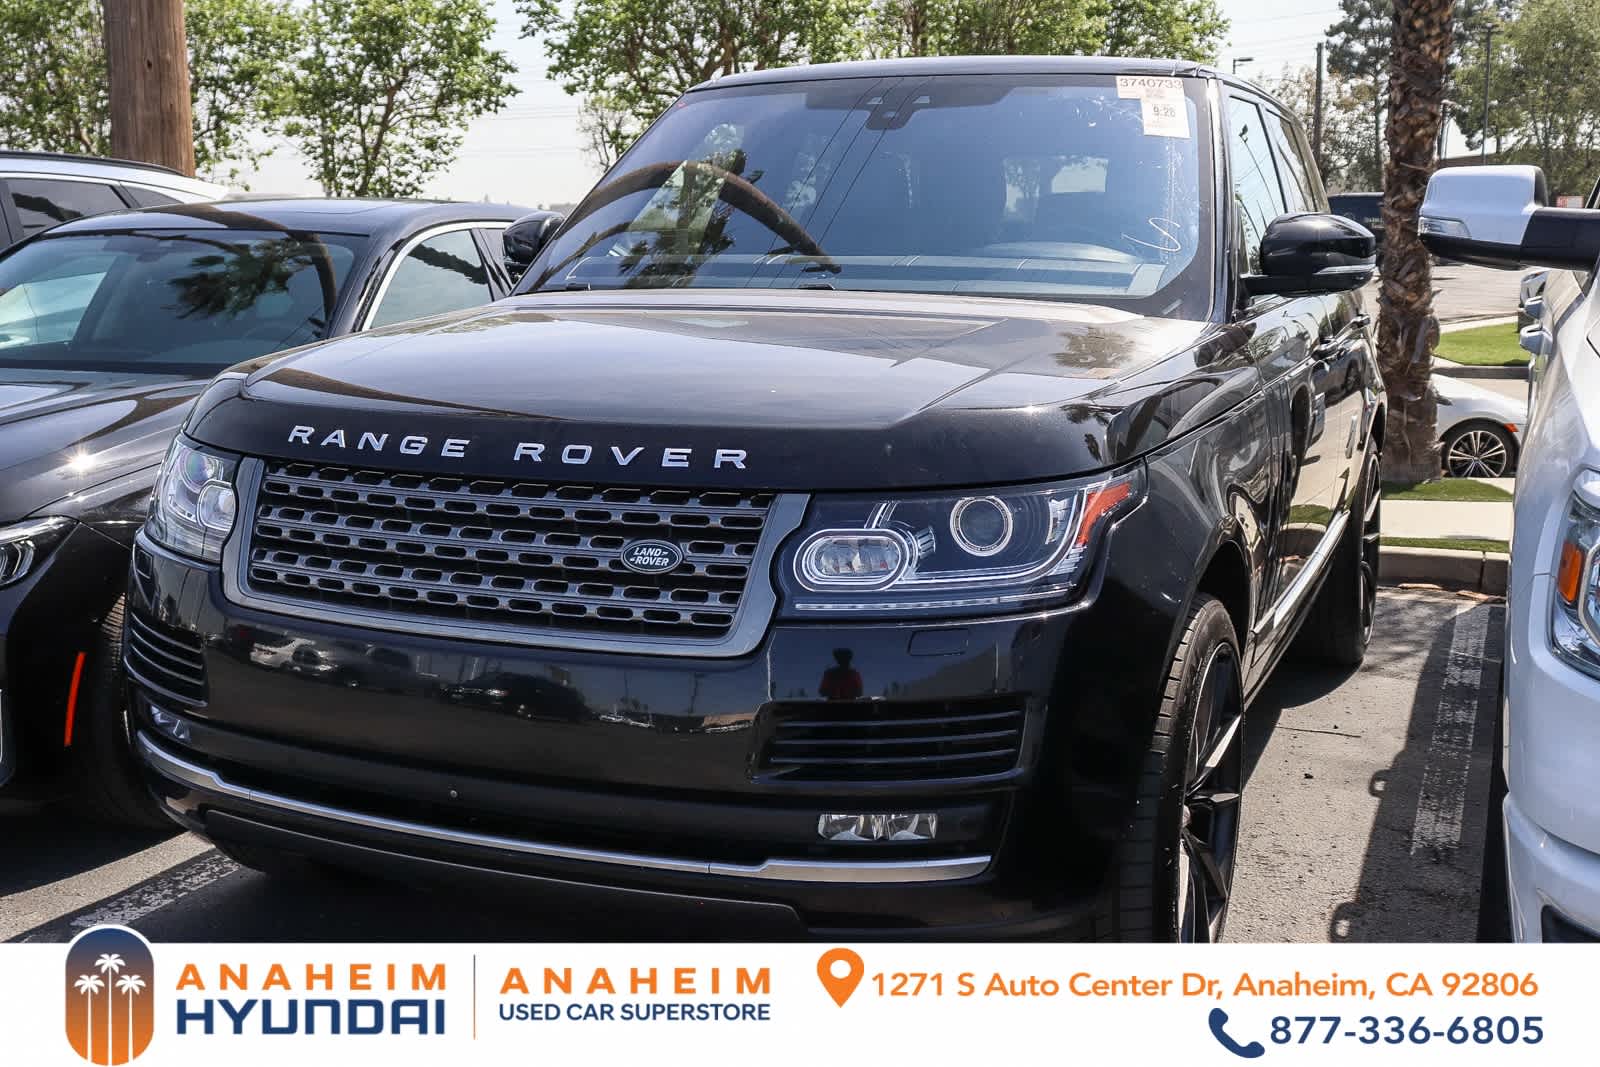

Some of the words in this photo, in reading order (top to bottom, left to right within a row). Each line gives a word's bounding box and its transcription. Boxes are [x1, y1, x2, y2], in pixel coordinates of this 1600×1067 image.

[288, 425, 471, 458] RANGE
[513, 442, 747, 469] ROVER
[633, 546, 662, 557] LAND
[634, 556, 670, 567] ROVER
